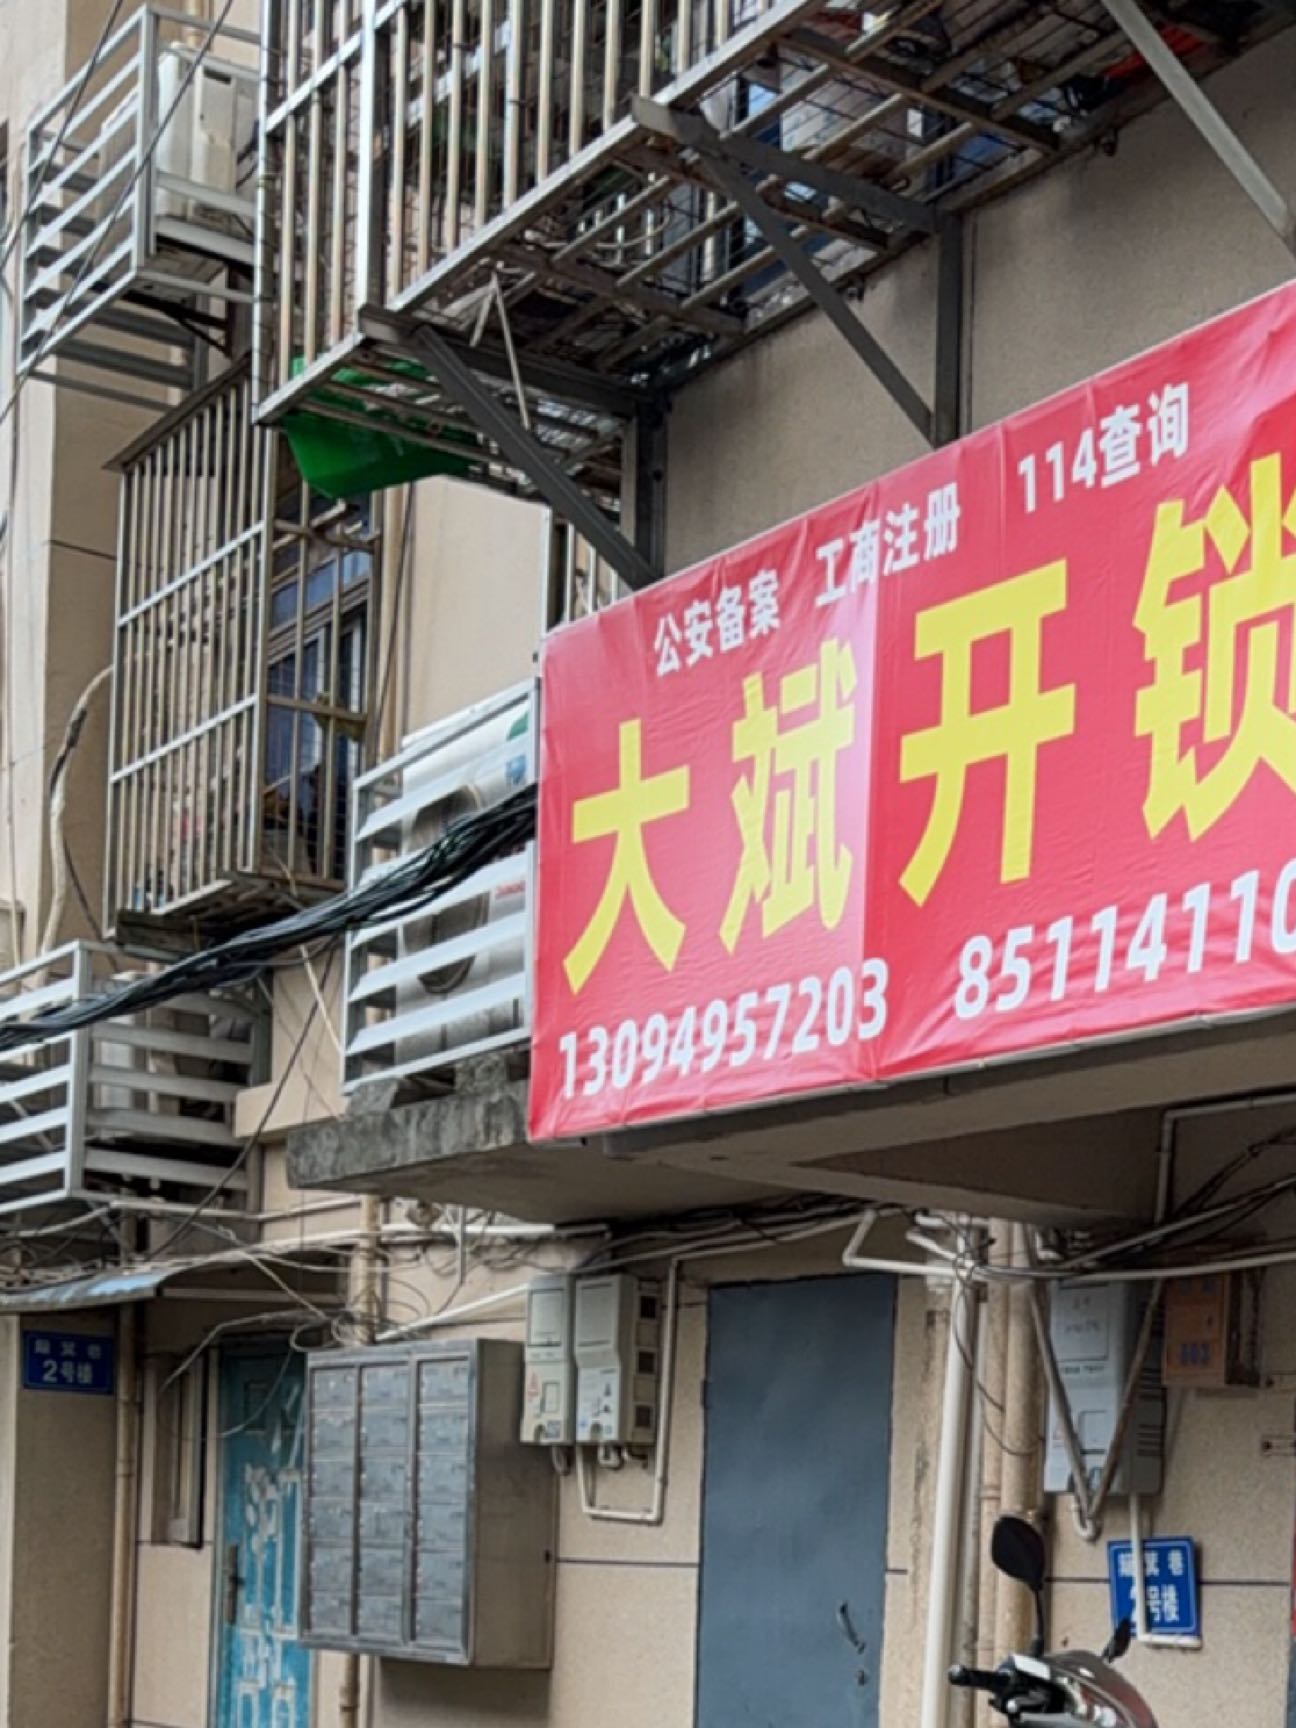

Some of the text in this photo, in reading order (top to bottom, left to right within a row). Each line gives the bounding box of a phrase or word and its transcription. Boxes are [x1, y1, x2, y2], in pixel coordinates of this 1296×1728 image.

[654, 383, 1190, 677] 公安备案 工商注册 114查询
[559, 957, 889, 1099] 13094957203
